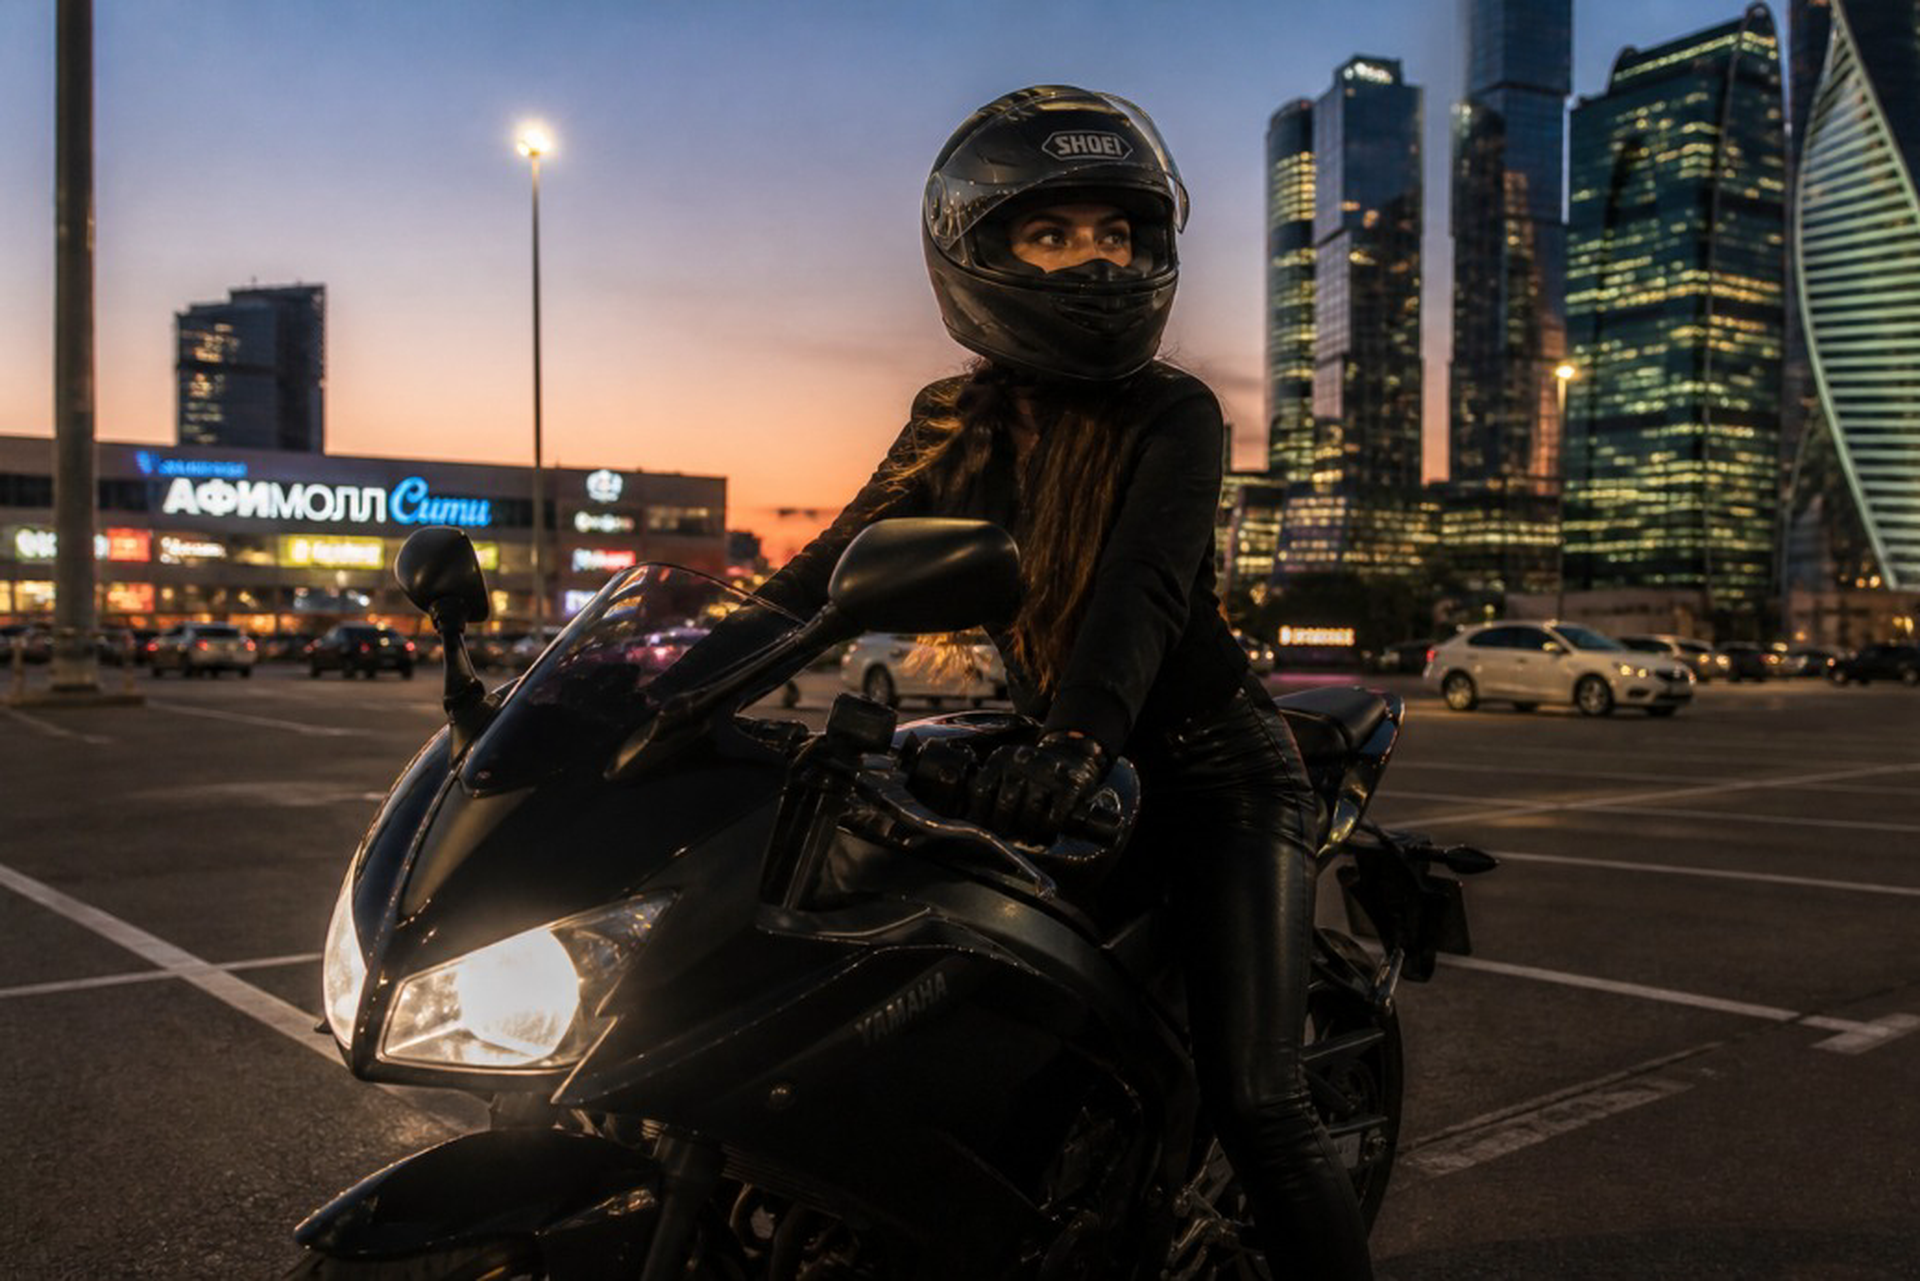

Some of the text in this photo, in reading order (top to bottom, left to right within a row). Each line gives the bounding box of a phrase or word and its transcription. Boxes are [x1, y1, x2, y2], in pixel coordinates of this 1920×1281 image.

[1055, 135, 1122, 155] SHOEI
[163, 476, 491, 526] АФИМОЛЛ Сити
[855, 972, 947, 1045] YAMAHA
